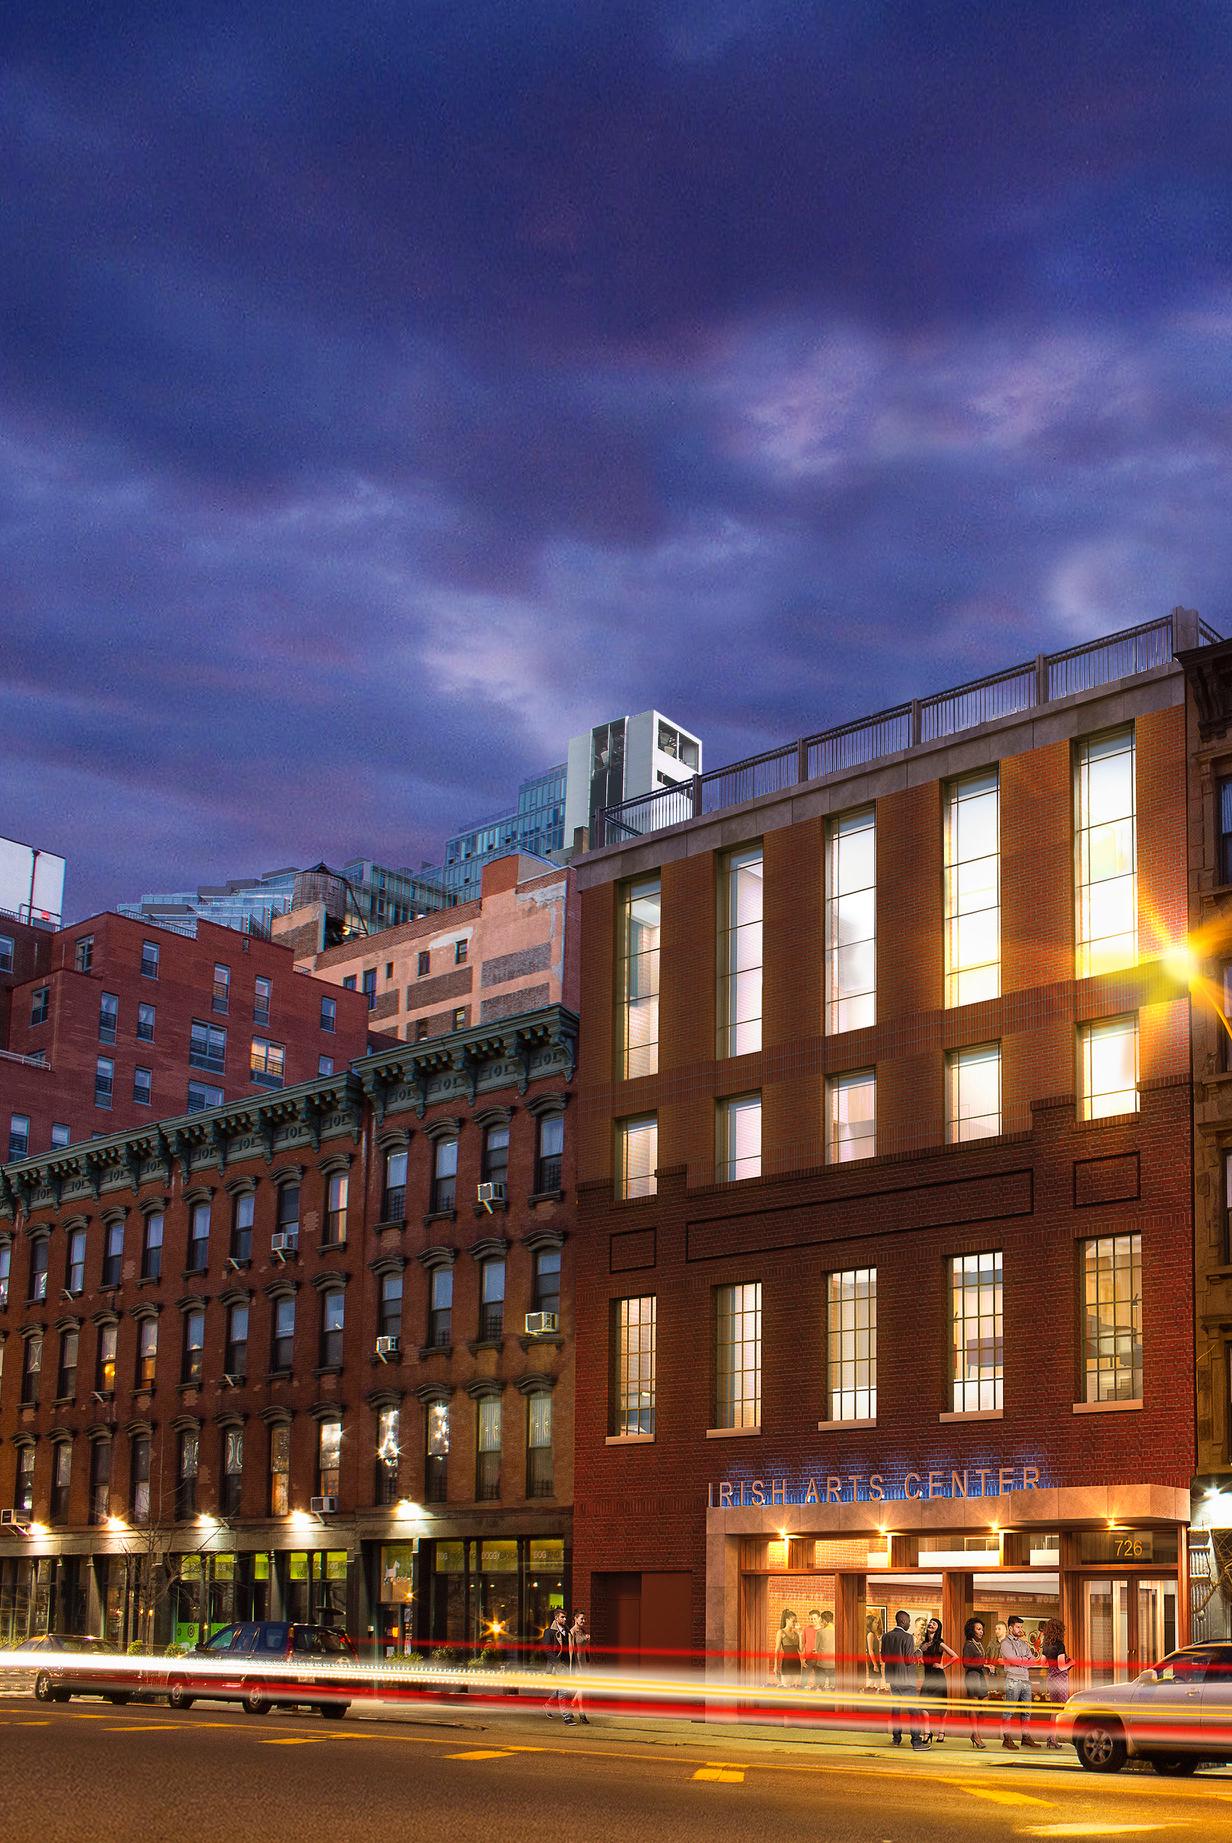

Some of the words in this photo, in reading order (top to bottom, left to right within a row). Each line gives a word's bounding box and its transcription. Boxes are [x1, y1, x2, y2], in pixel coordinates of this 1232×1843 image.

[708, 1478, 786, 1508] IRISH
[805, 1474, 885, 1504] ARTS
[904, 1466, 1042, 1500] CENTER
[1115, 1539, 1143, 1557] 726
